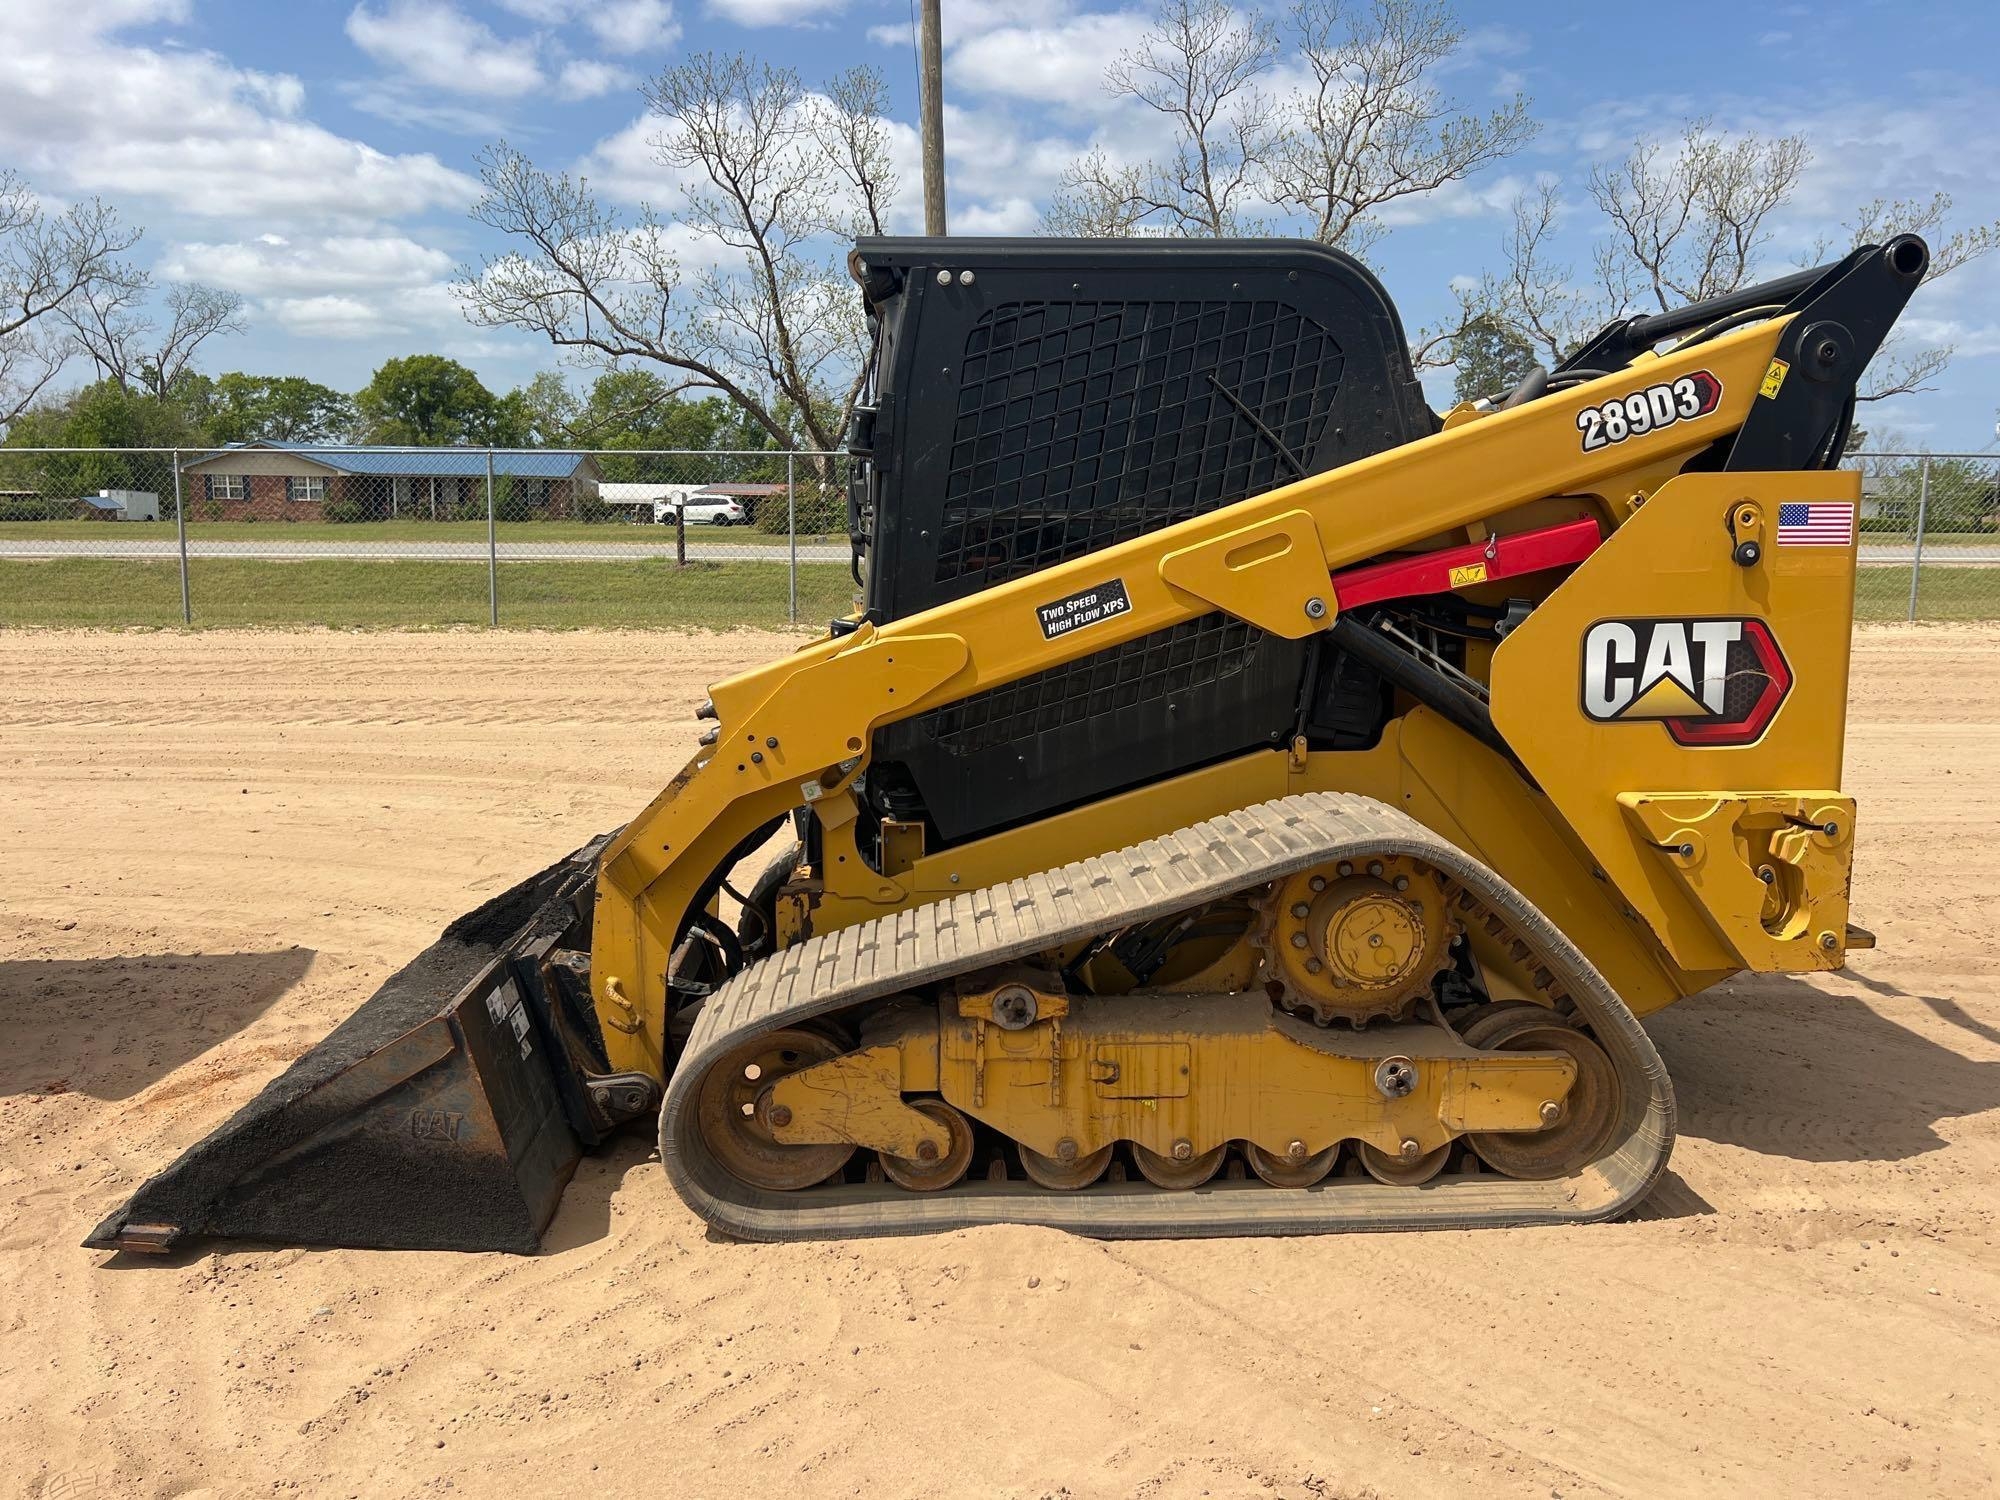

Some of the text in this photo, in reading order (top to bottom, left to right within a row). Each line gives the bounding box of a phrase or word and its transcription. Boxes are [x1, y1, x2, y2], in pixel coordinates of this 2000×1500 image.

[1578, 378, 1701, 450] 289D3
[1103, 597, 1125, 615] XPS
[1585, 621, 1742, 718] CAT
[410, 1108, 463, 1142] CAT
